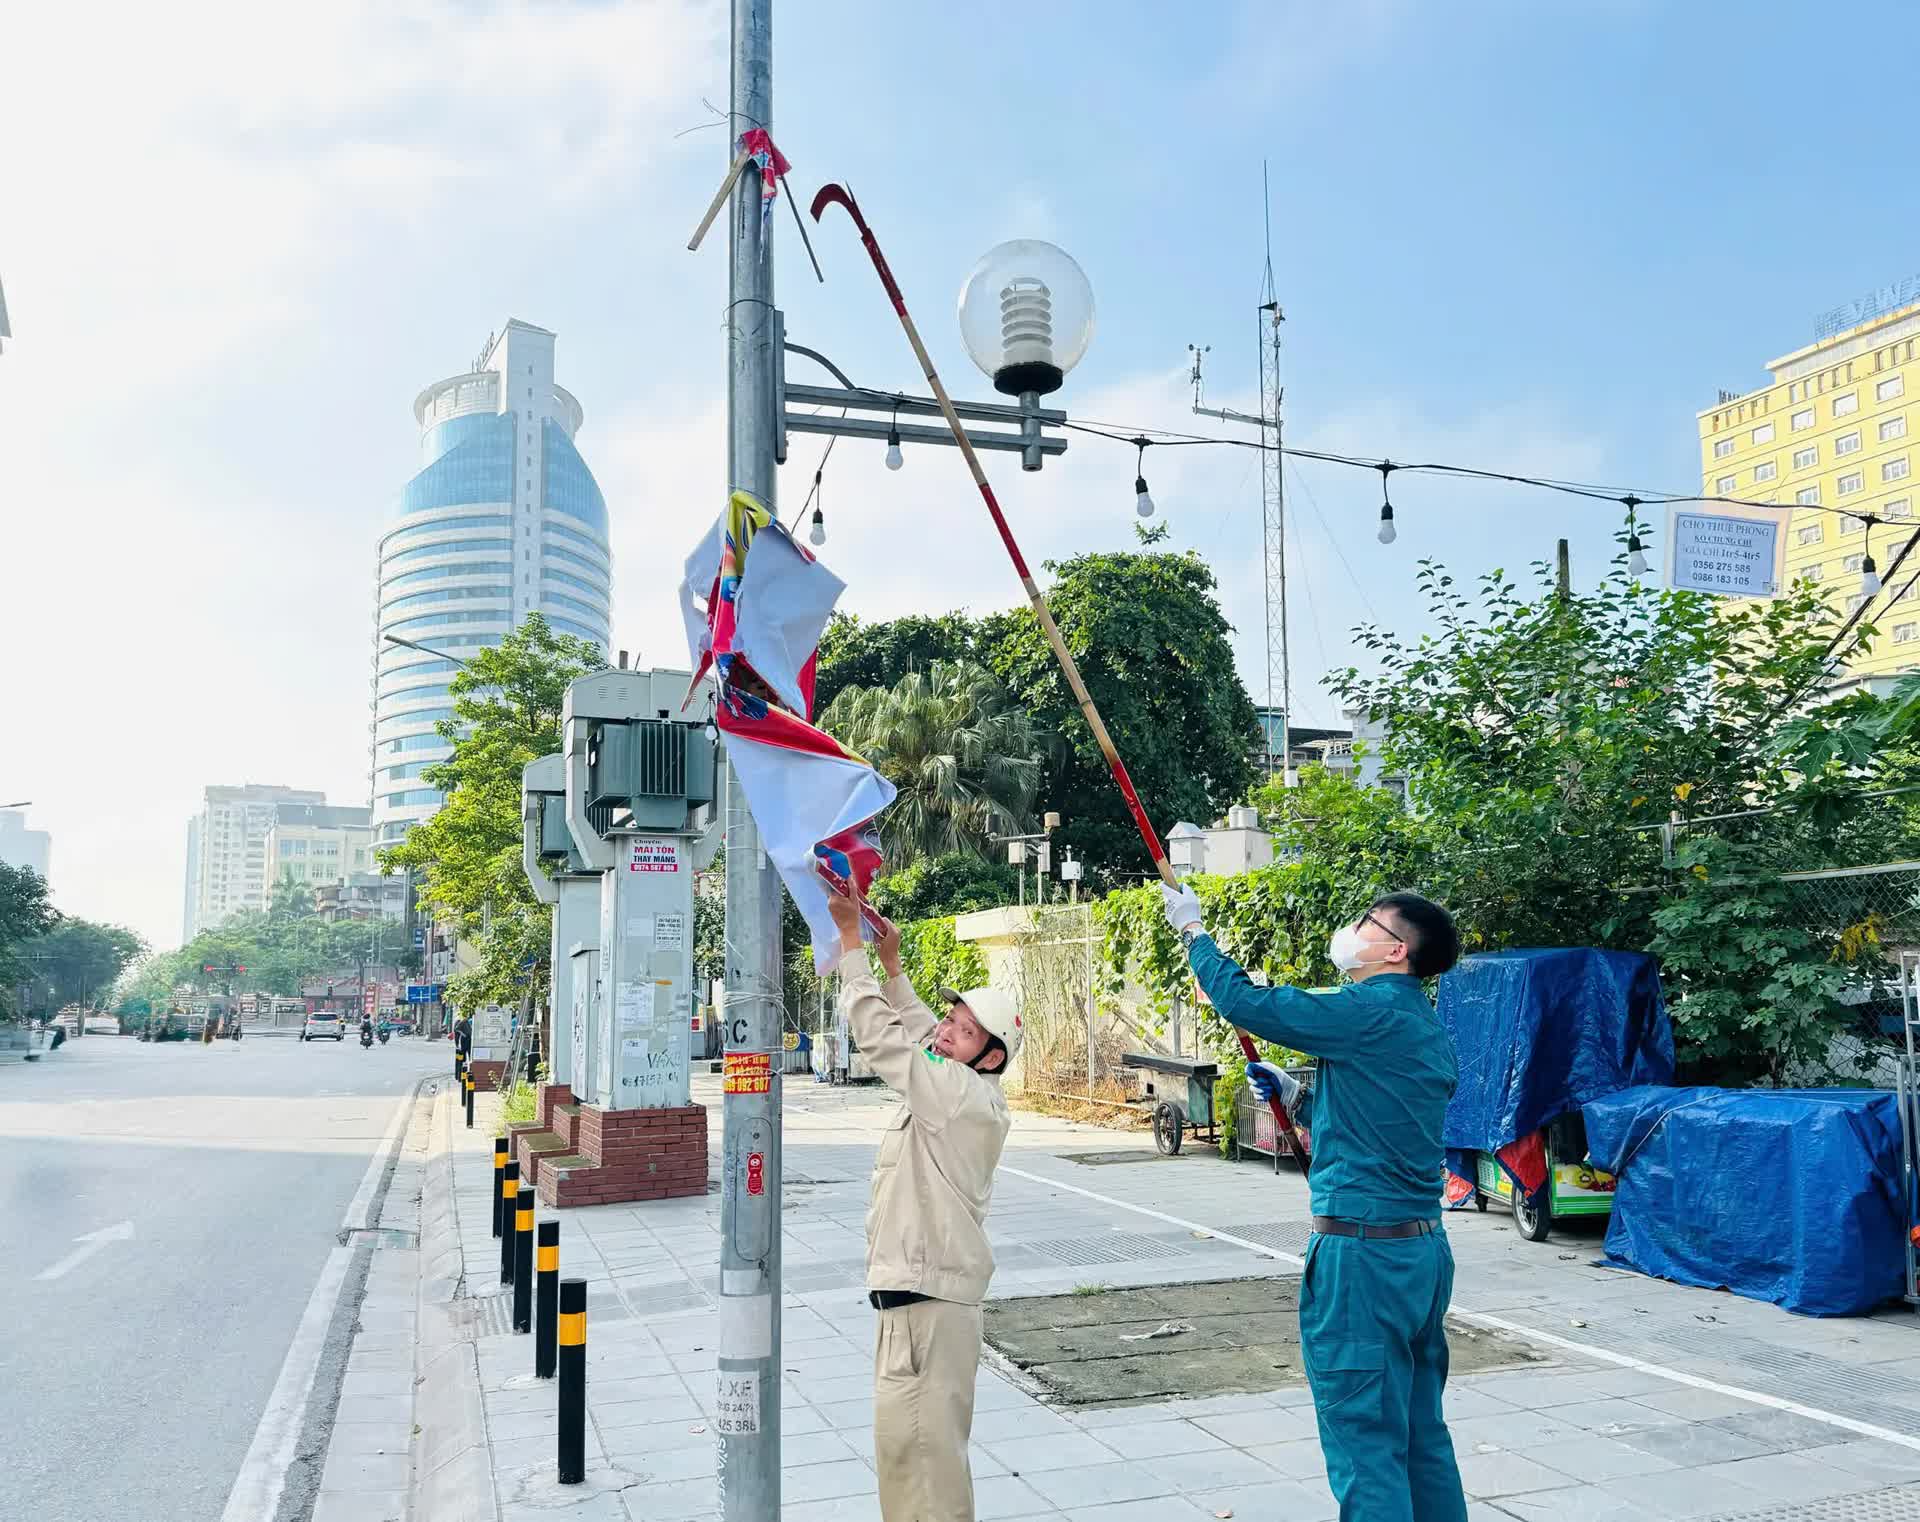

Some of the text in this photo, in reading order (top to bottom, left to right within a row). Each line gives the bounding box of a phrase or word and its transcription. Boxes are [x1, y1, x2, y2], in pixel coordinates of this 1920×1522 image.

[1682, 519, 1705, 530] CHO
[1693, 559, 1751, 573] 0356 275 585
[1692, 572, 1750, 586] 0986 183 105
